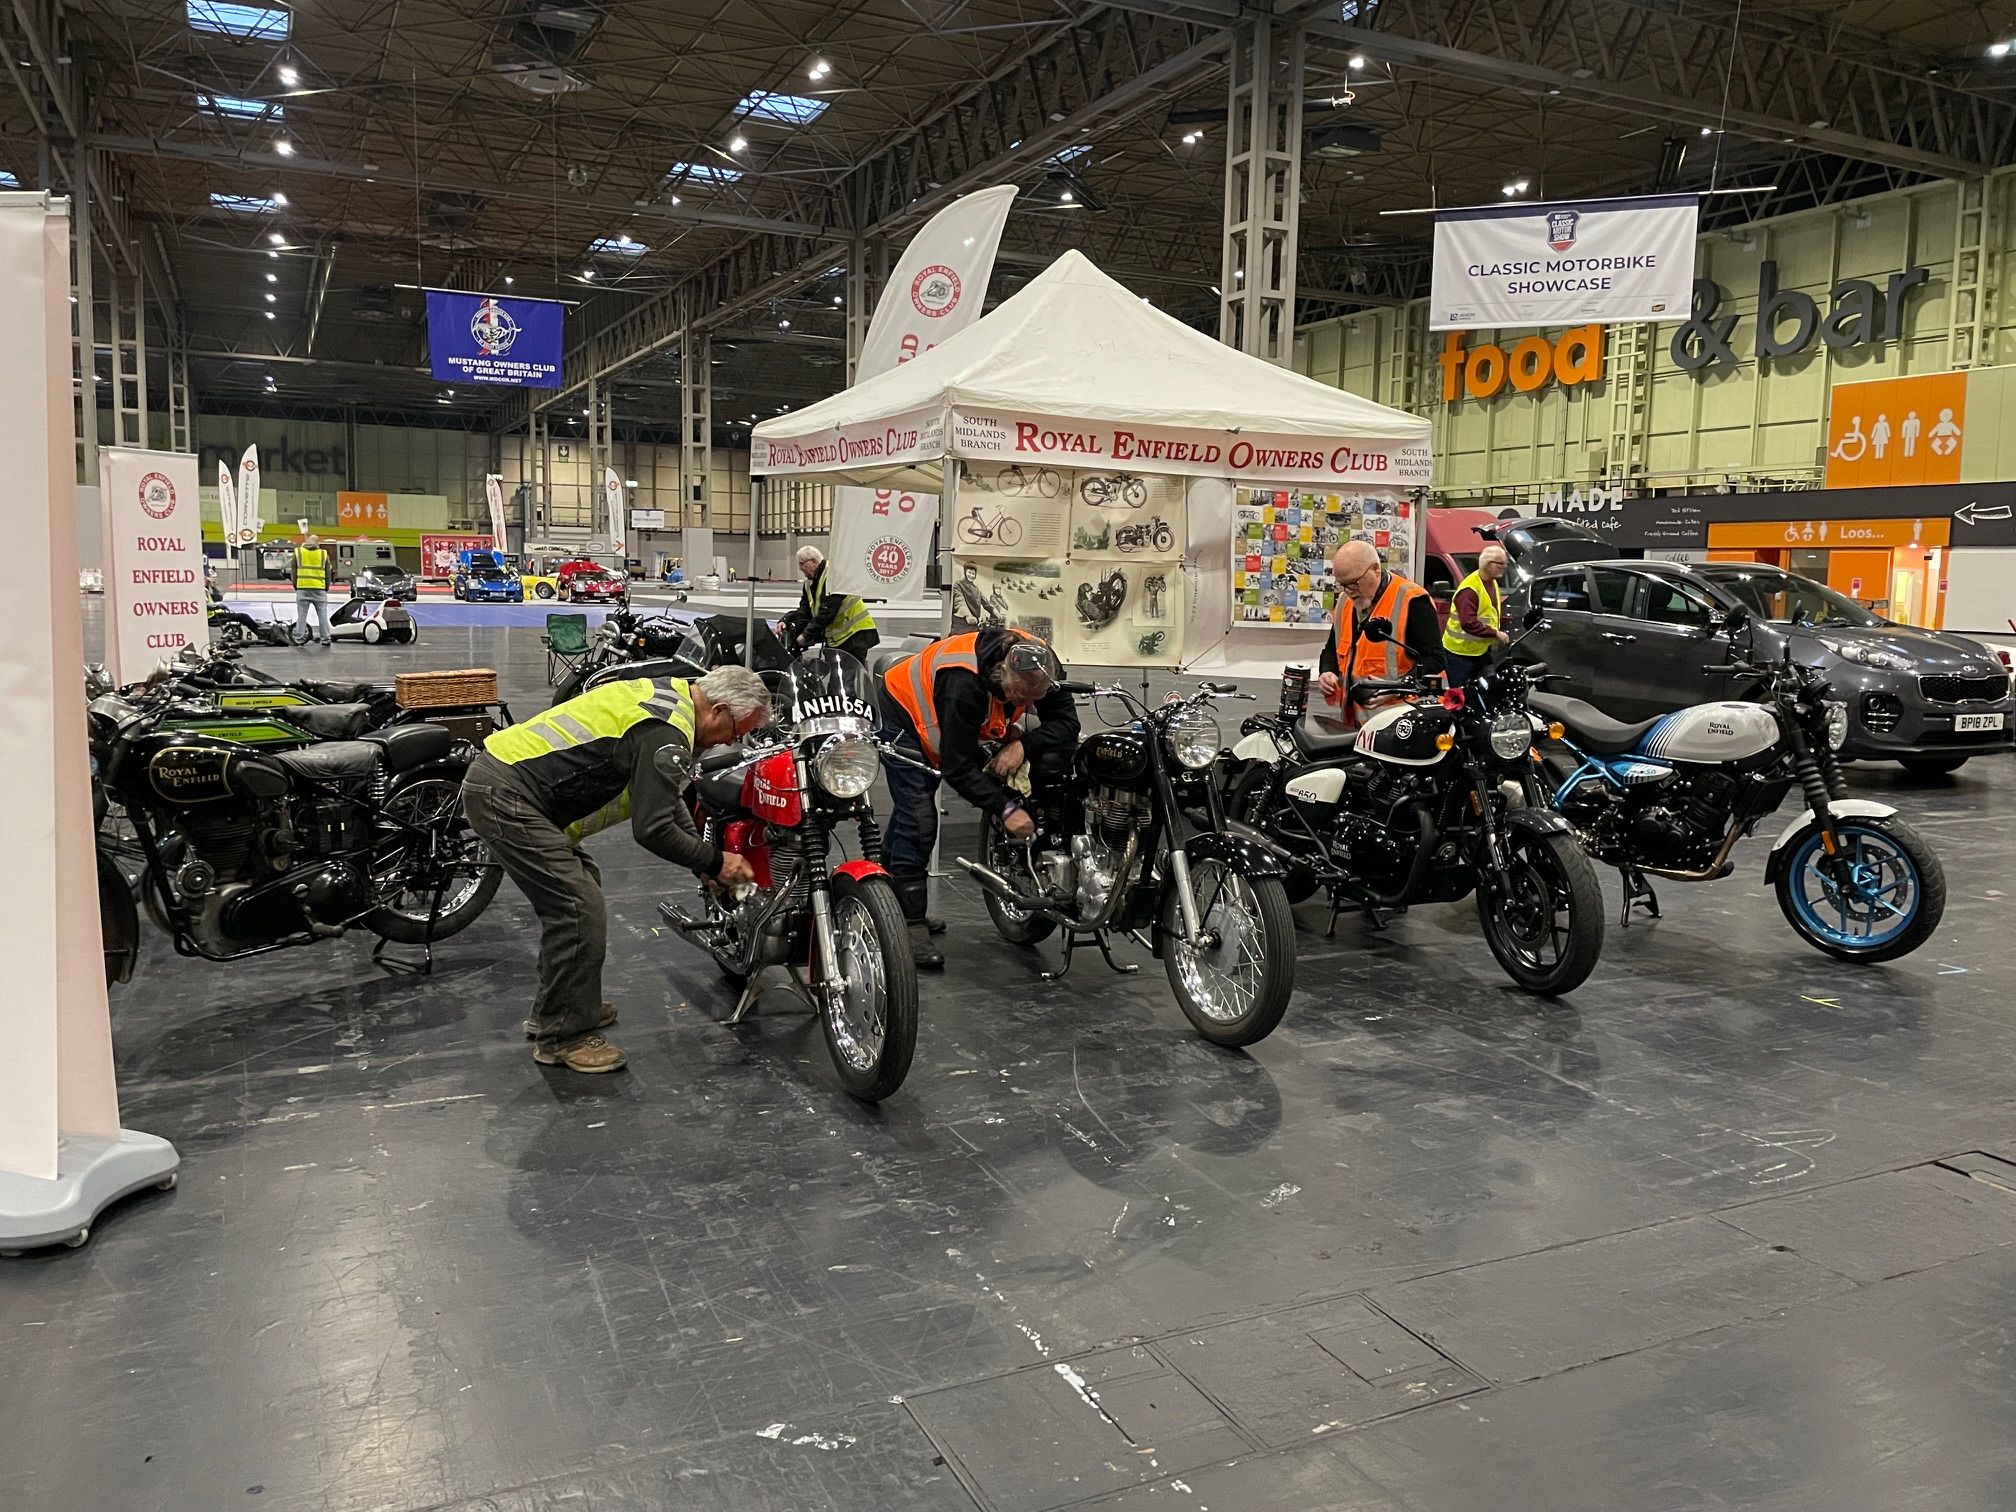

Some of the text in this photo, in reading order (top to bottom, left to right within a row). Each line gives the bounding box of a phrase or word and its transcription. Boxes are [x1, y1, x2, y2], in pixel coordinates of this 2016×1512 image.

[1468, 255, 1656, 277] CLASSIC MOTORBIKE
[914, 266, 960, 293] ROYAL ENFIELD
[1508, 278, 1612, 294] SHOWCASE
[912, 291, 958, 316] OWNERS CLUB
[1669, 276, 1741, 372] &
[1755, 260, 1931, 359] bar
[448, 358, 556, 372] MUSTANG OWNERS CLUB
[476, 367, 505, 376] GREAT
[508, 369, 542, 378] BRITAIN
[963, 416, 997, 426] SOUTH
[955, 426, 1006, 440] MIDLANDS
[768, 444, 797, 467] ROYAL
[794, 443, 836, 466] ENFIELD
[838, 436, 883, 463] OWNERS
[886, 428, 918, 456] CLUB
[960, 440, 1000, 450] BRANCH
[1015, 422, 1388, 474] ROYAL ENFIELD OWNERS CLUB
[1402, 448, 1428, 457] SOUTH
[1394, 458, 1432, 467] MIDLANDS
[1399, 469, 1430, 477] BRANCH
[1541, 486, 1624, 514] MADE
[1602, 516, 1622, 531] cafe
[1840, 526, 1884, 539] Loos...
[138, 536, 186, 552] ROYAL
[868, 538, 912, 560] ROYAL ENFIELD
[878, 550, 898, 564] 40
[132, 570, 194, 584] ENFIELD
[866, 562, 909, 584] OWNERS CLUB
[134, 602, 198, 616] OWNERS
[146, 634, 186, 648] CLUB
[1710, 722, 1730, 730] ROYAL
[1961, 716, 1998, 728] BP18 ZPL
[1708, 728, 1734, 736] ENFIELD
[158, 766, 198, 780] ROYAL
[172, 772, 220, 788] ENFIELD
[758, 790, 787, 808] ENFIELD
[1298, 790, 1316, 800] 650
[1332, 840, 1348, 852] ROYAL
